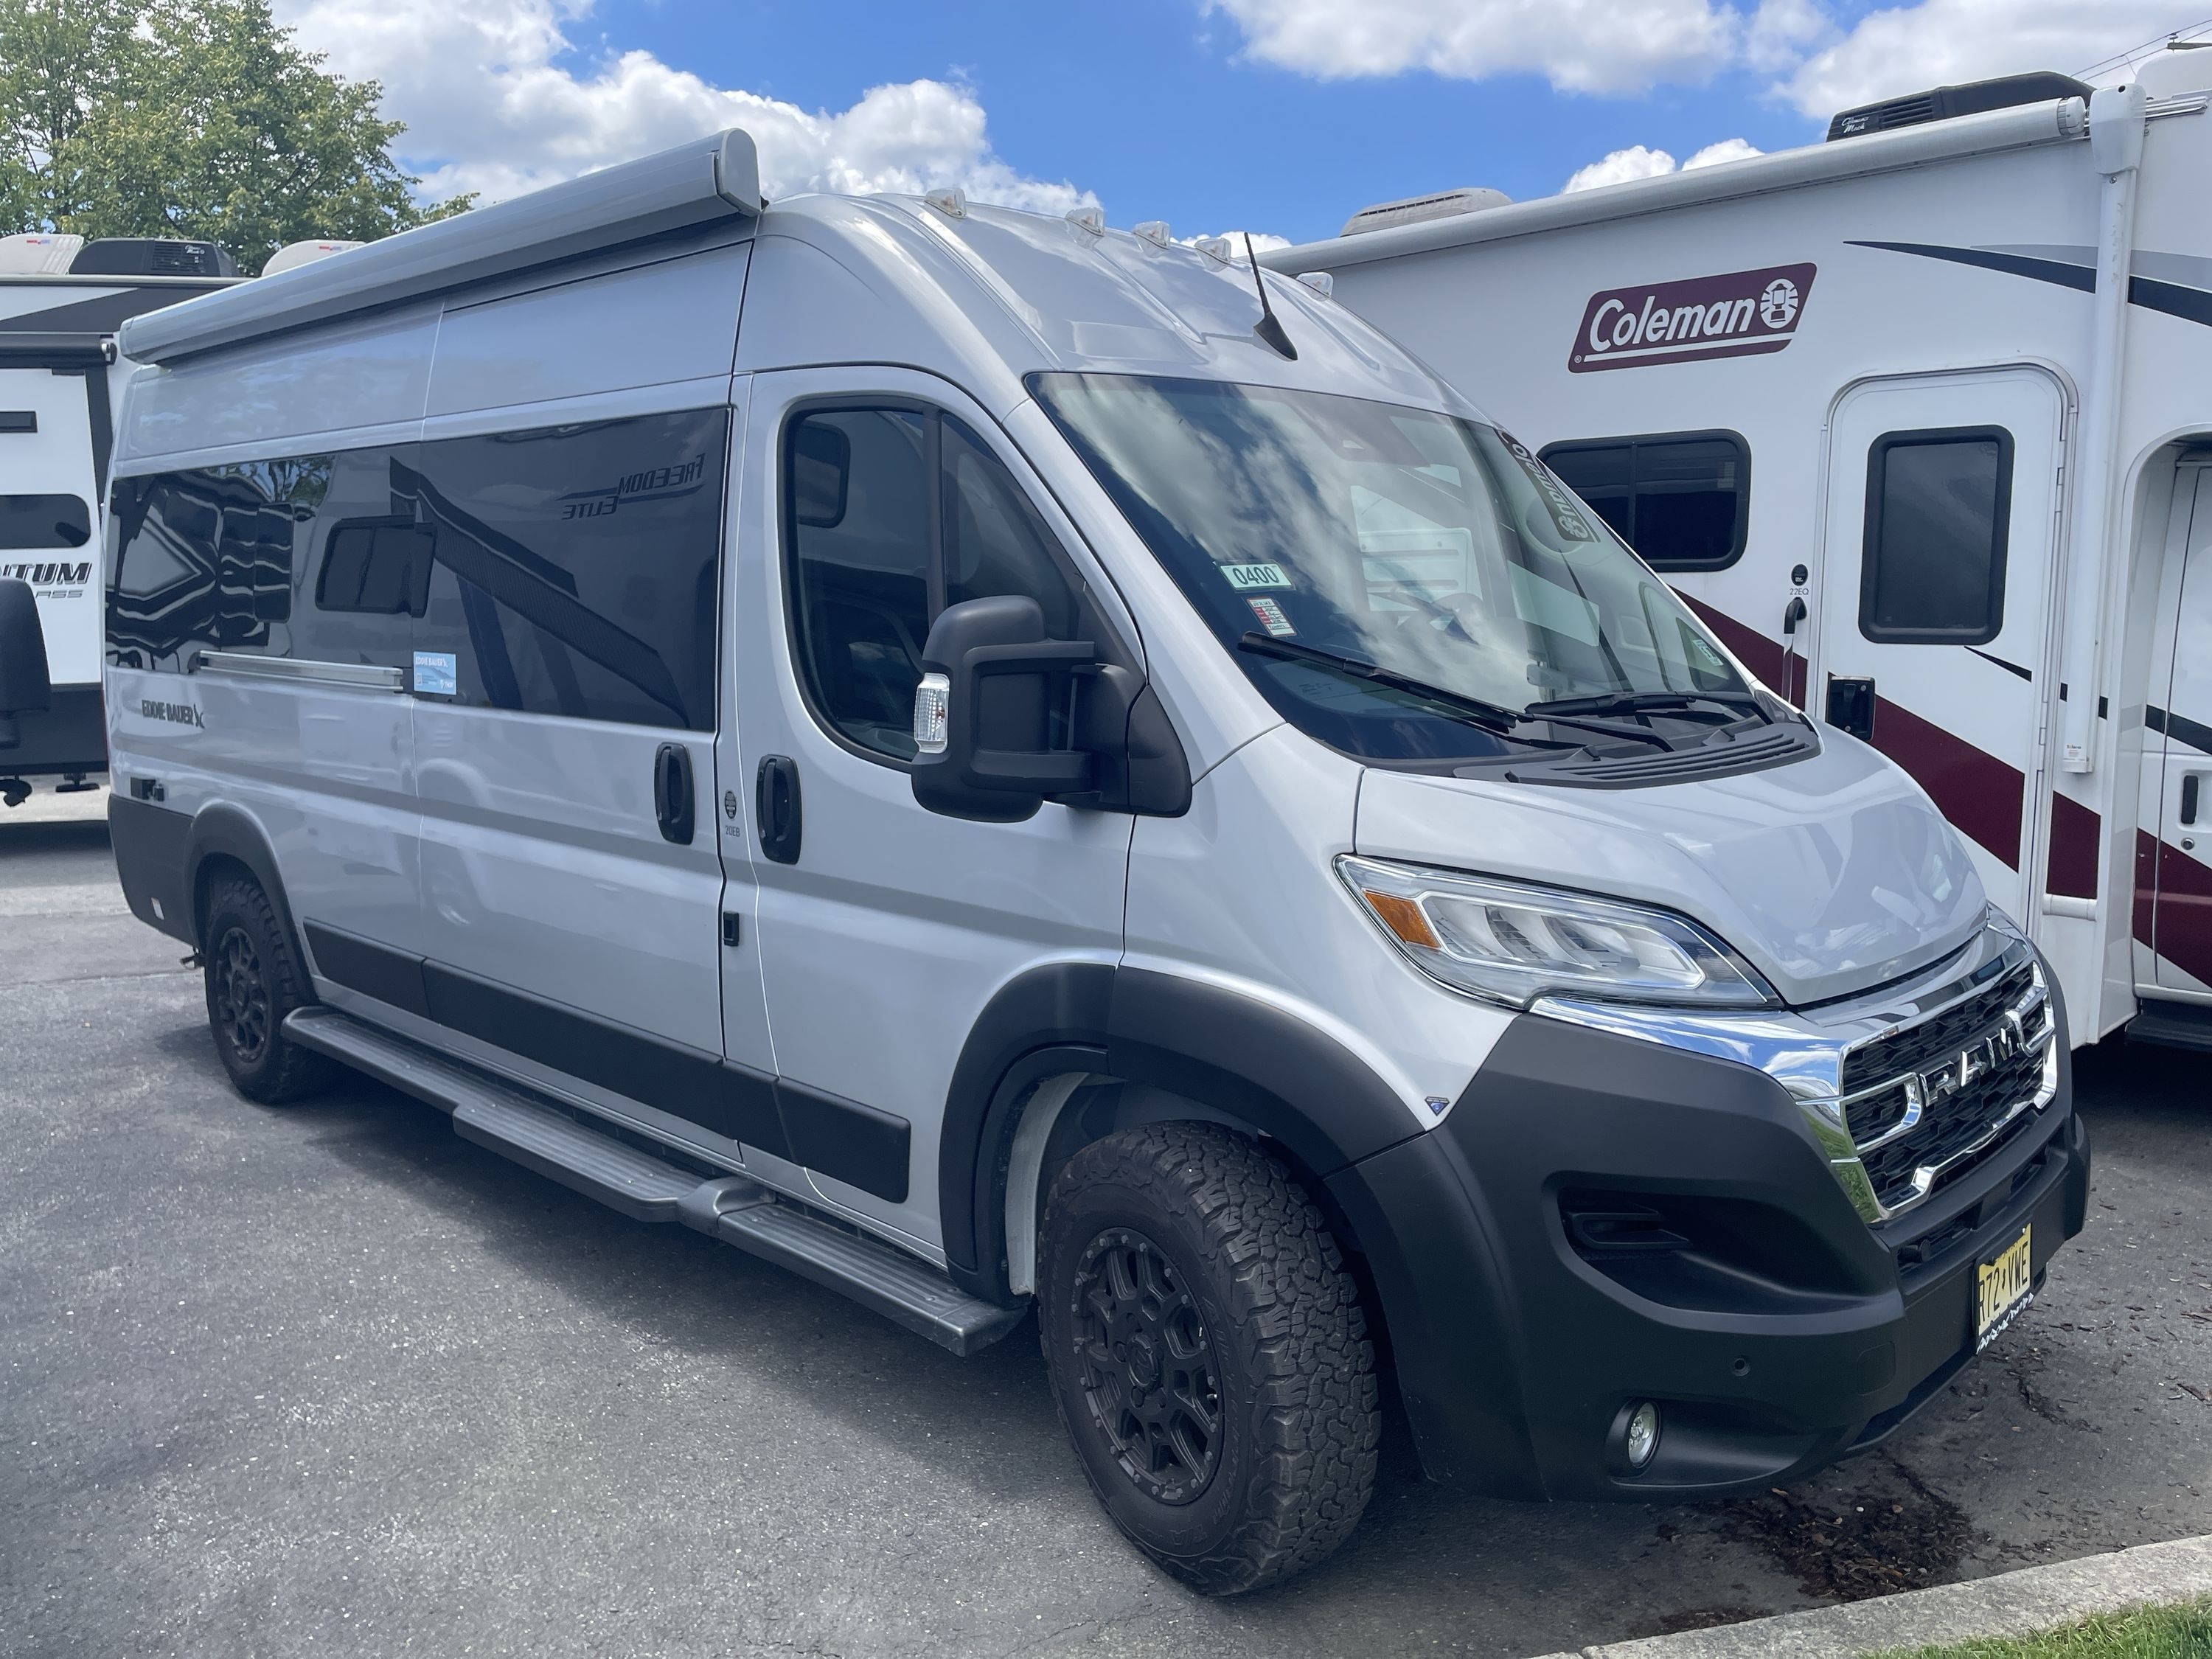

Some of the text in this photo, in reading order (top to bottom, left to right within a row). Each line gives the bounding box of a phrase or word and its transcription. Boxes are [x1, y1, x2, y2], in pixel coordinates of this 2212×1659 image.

[1590, 296, 1756, 352] Coleman
[1232, 566, 1279, 585] 0400
[35, 590, 84, 599] ASS
[1790, 588, 1809, 596] 22EQ
[142, 699, 194, 726] EDDIE BAUER
[725, 825, 740, 838] 20EB
[1919, 1027, 2019, 1107] RAM
[2008, 1240, 2028, 1297] VWE
